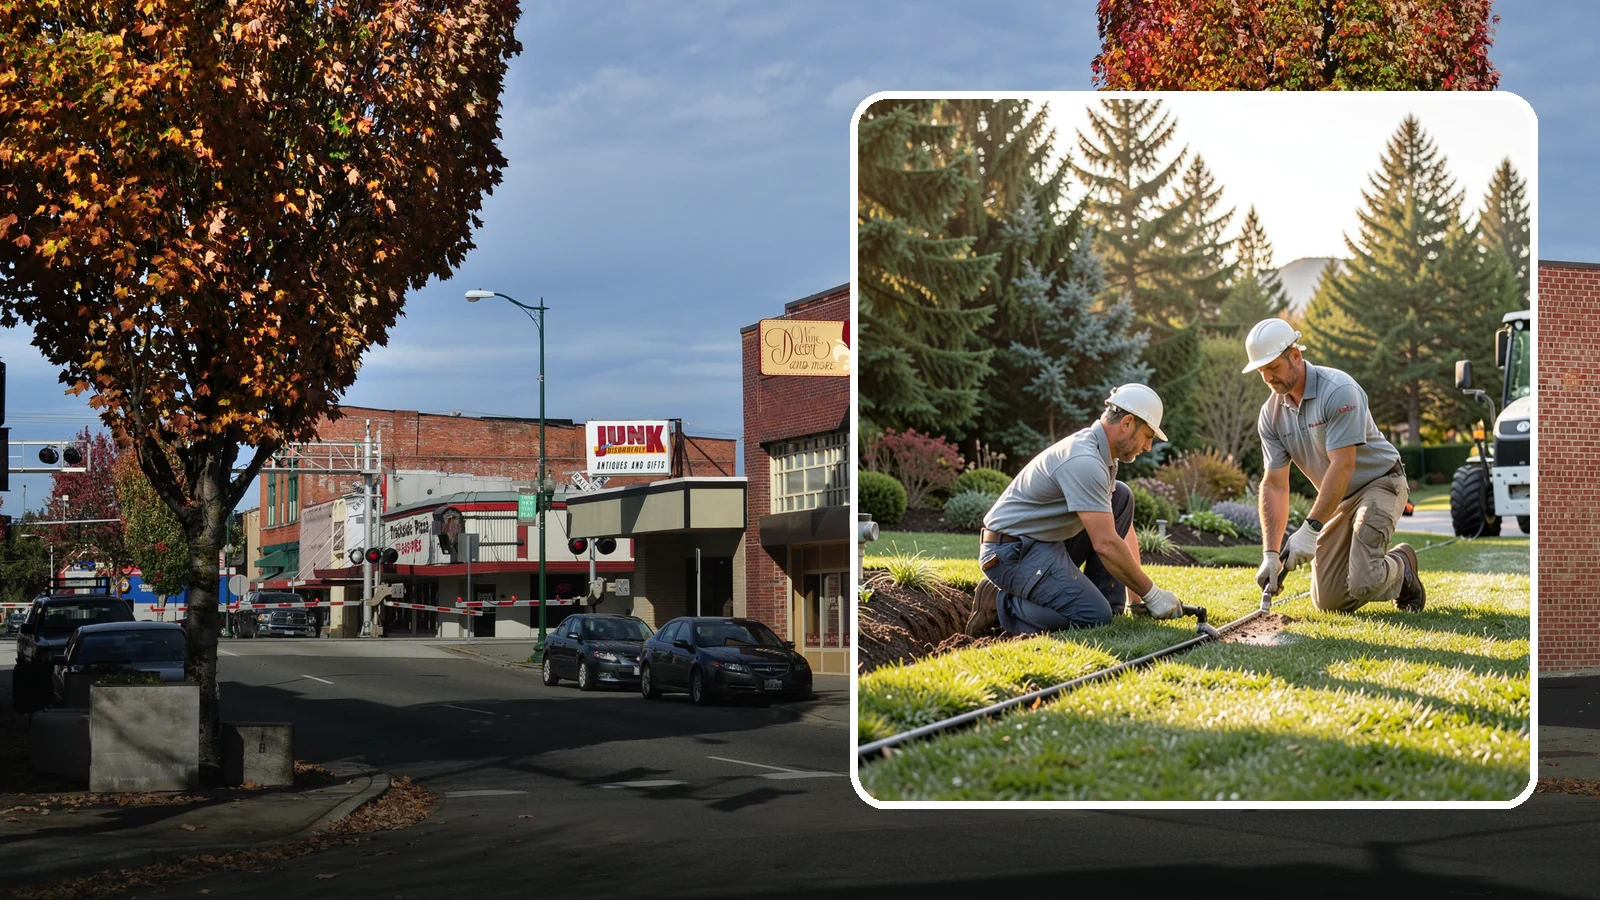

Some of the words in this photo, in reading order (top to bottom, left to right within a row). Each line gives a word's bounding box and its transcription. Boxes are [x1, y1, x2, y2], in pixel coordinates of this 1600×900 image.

[595, 425, 665, 457] JUNK
[607, 446, 646, 454] DISORDERLY
[597, 461, 628, 470] ANTIQUES
[631, 461, 644, 470] AND
[647, 460, 665, 469] GIFTS
[390, 522, 413, 540] Trackside
[414, 519, 429, 535] Pizza
